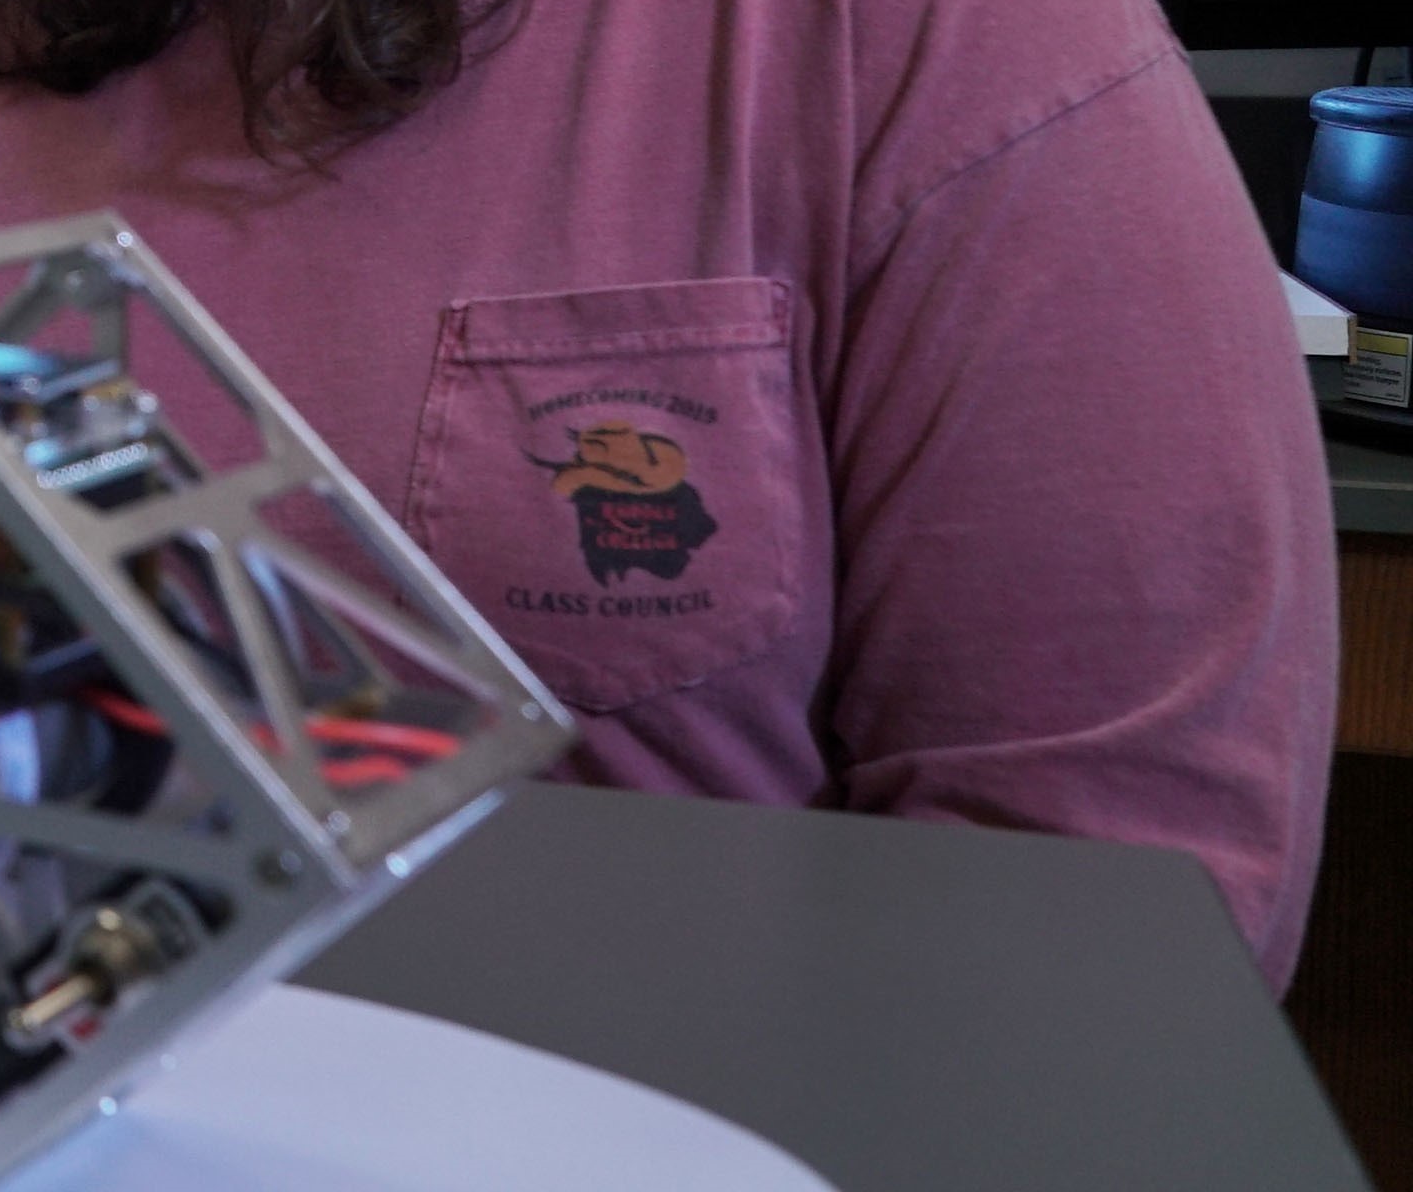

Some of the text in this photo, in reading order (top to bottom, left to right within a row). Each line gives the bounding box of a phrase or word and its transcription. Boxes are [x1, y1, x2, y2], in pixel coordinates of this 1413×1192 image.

[529, 389, 662, 422] HOMECOMING
[505, 587, 716, 619] CLASS COUNCIL
